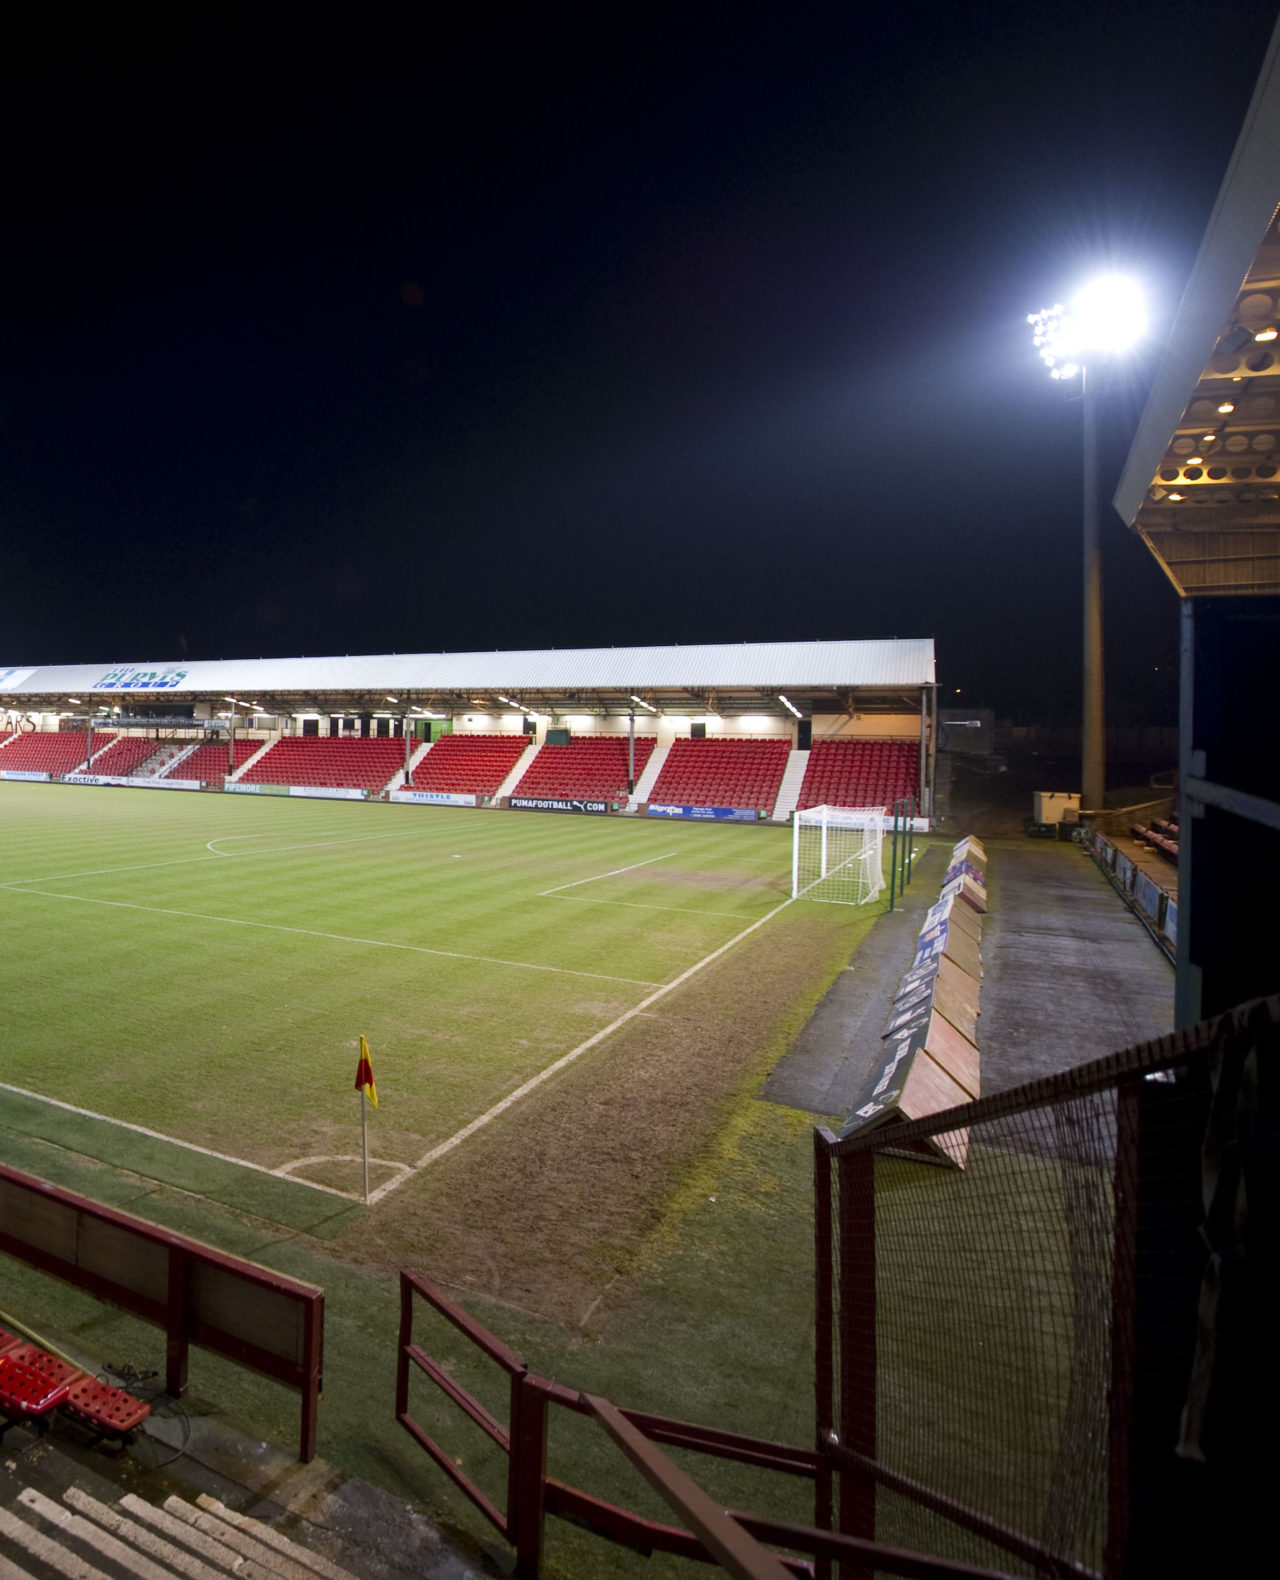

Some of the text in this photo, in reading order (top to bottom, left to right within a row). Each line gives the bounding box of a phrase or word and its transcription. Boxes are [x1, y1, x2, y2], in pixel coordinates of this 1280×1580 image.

[61, 774, 100, 785] Exactive
[224, 782, 261, 793] PIPEMORE
[412, 792, 451, 800] THISTLE
[511, 798, 605, 811] PUMAFOOTBALL COM
